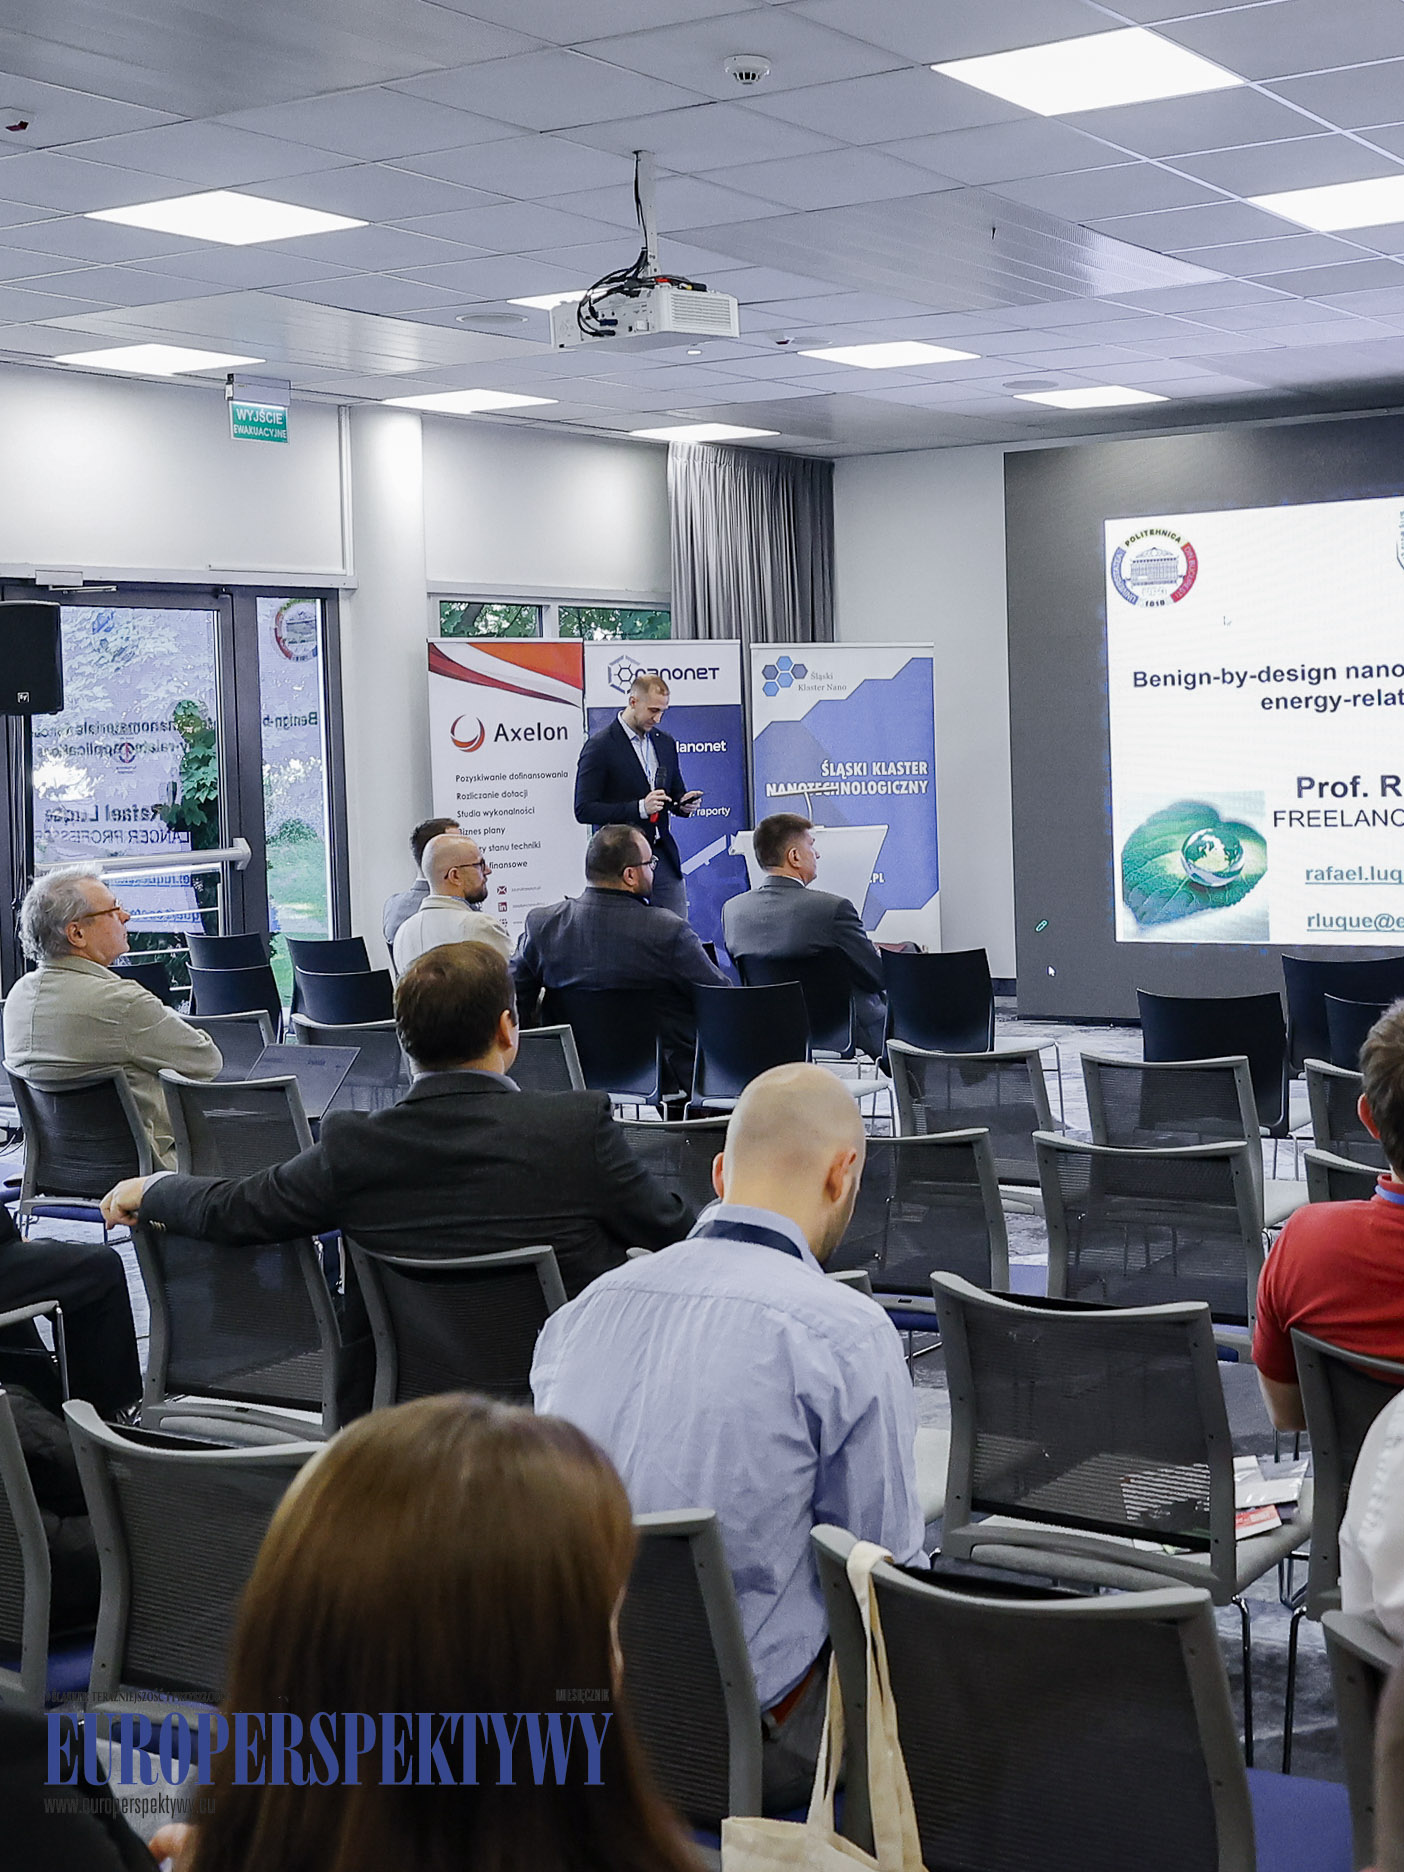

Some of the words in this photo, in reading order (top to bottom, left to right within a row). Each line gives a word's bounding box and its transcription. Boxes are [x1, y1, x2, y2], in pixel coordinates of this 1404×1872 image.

[236, 408, 284, 425] WYJŚCIE
[233, 424, 287, 439] EWAKUACYJNE
[1124, 528, 1182, 547] POLITEHNICA
[810, 671, 833, 682] Śląski
[1133, 664, 1337, 690] Benign-by-design
[798, 683, 825, 692] Klaster
[826, 683, 847, 691] Nano
[493, 721, 568, 742] Axelon
[821, 759, 868, 779] ŚLĄSKI
[872, 761, 928, 776] KLASTER
[455, 772, 507, 784] Pozyskiwanie
[508, 770, 569, 781] dofinansowania
[1296, 775, 1369, 799] Prof.
[456, 791, 500, 800] Rozliczanie
[501, 789, 529, 799] dotacji
[456, 809, 481, 818] Studia
[482, 806, 536, 818] wykonalności
[697, 806, 731, 818] raporty
[483, 826, 506, 836] plany
[488, 843, 510, 852] stanu
[511, 841, 542, 851] techniki
[489, 860, 528, 869] finansowe
